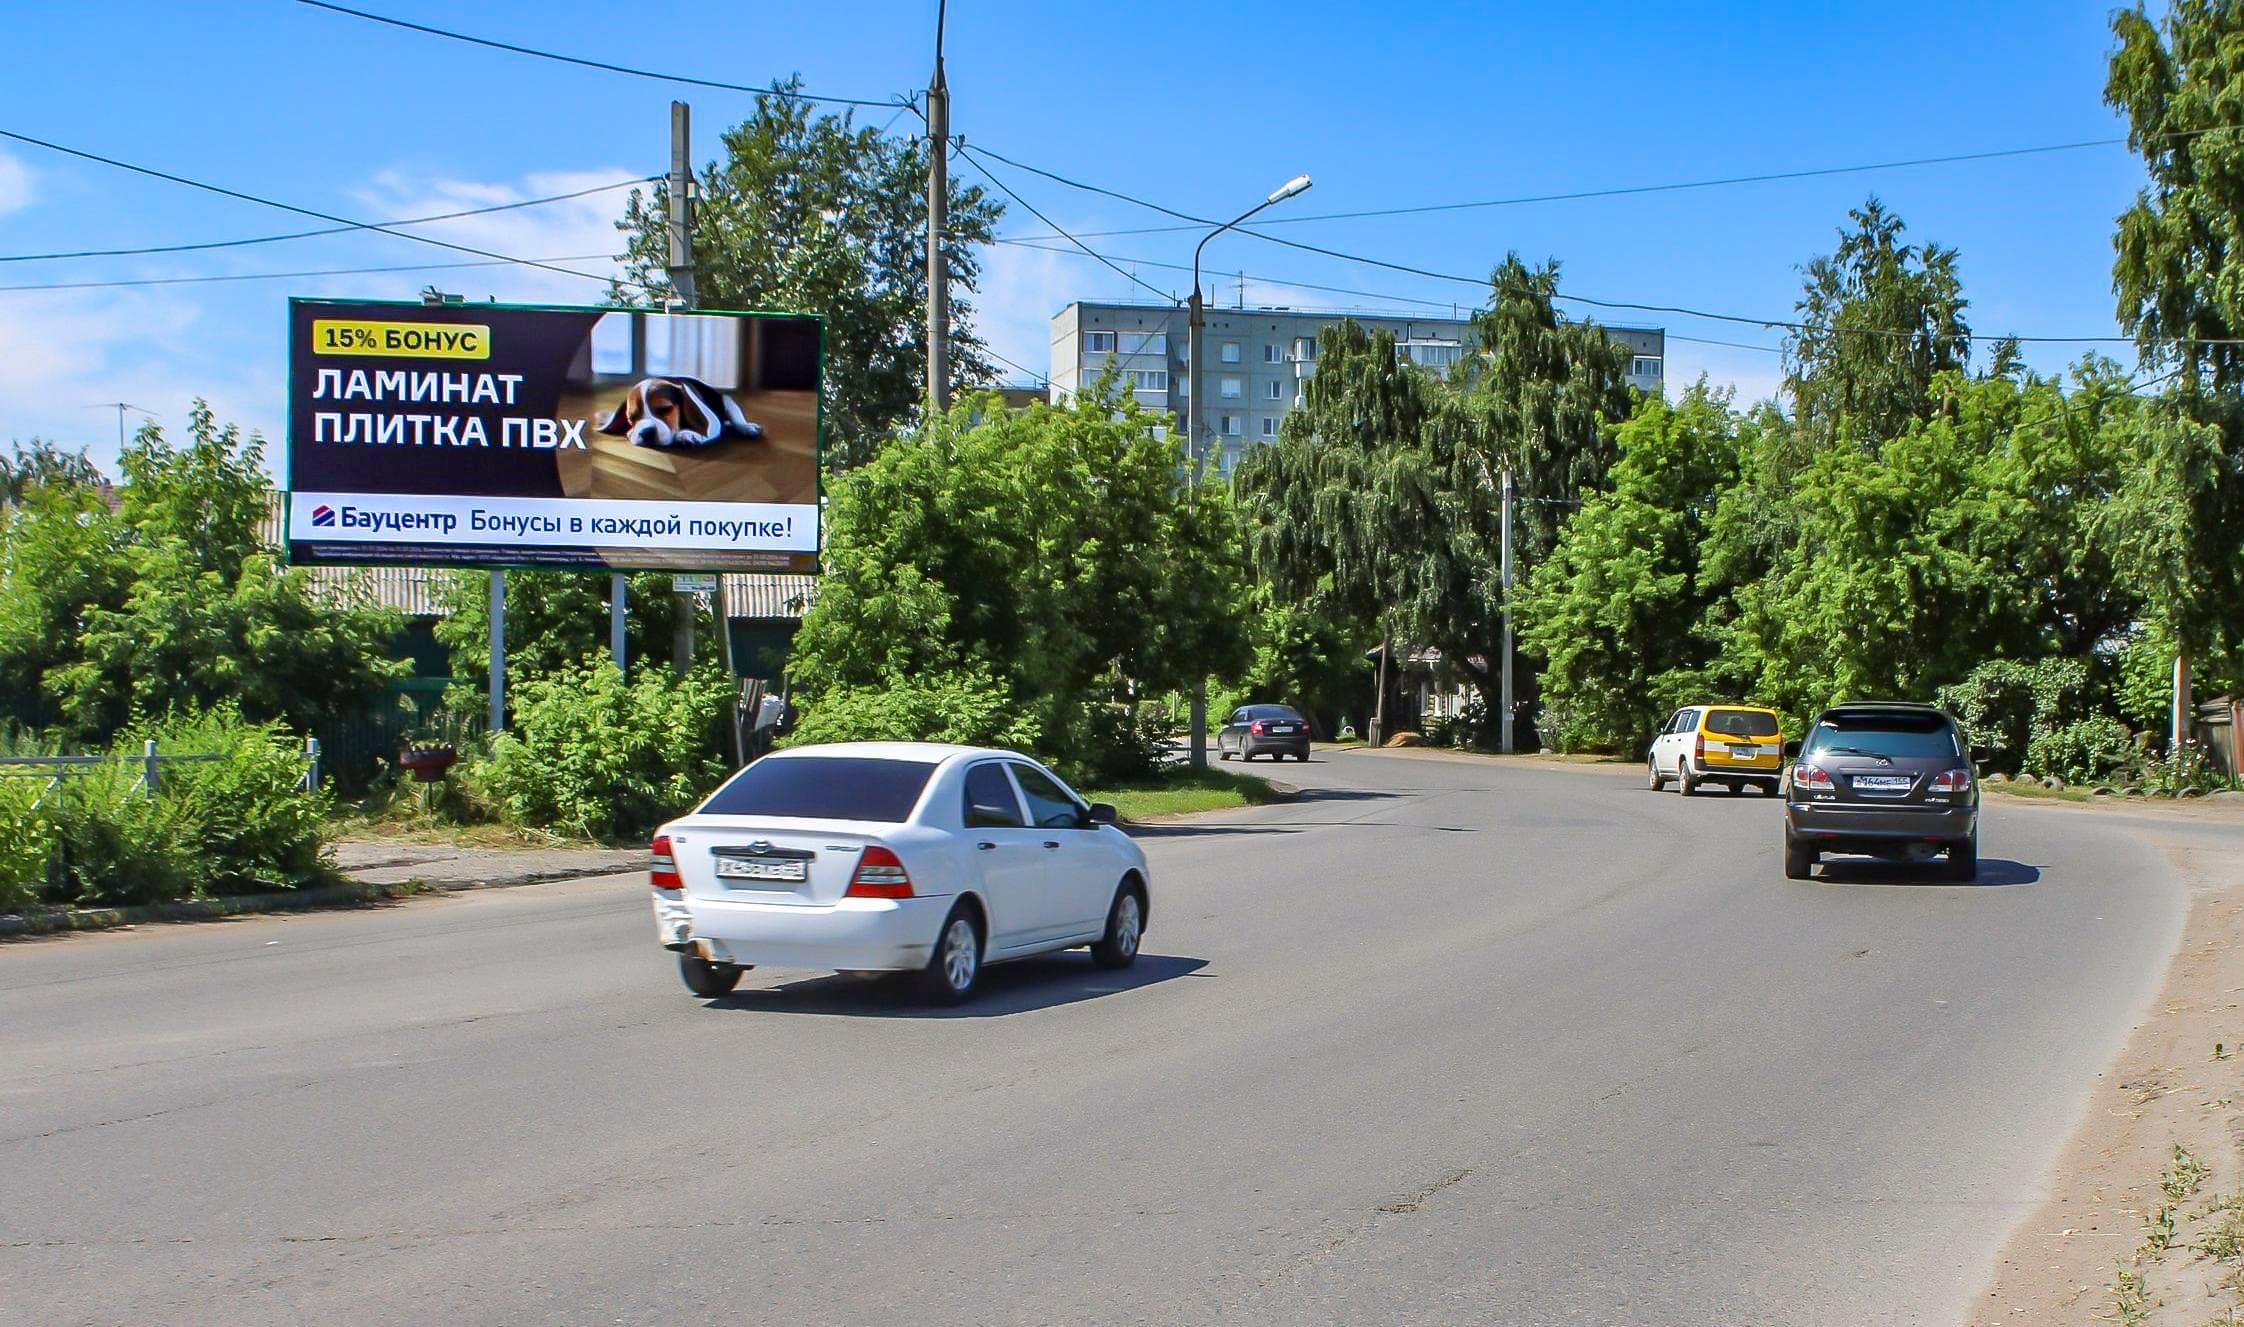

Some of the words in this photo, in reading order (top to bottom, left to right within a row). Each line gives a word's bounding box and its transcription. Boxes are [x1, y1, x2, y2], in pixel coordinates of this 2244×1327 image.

[326, 328, 377, 348] 15%
[385, 330, 477, 351] БОНУС
[313, 368, 523, 404] ЛАМИНАТ
[315, 412, 488, 447] ПЛИТКА
[502, 417, 587, 450] ПВХ
[341, 507, 457, 534] Бауцентр
[471, 509, 561, 536] Бонусы
[570, 517, 583, 533] в
[591, 514, 681, 538] каждой
[689, 517, 792, 542] покупке!
